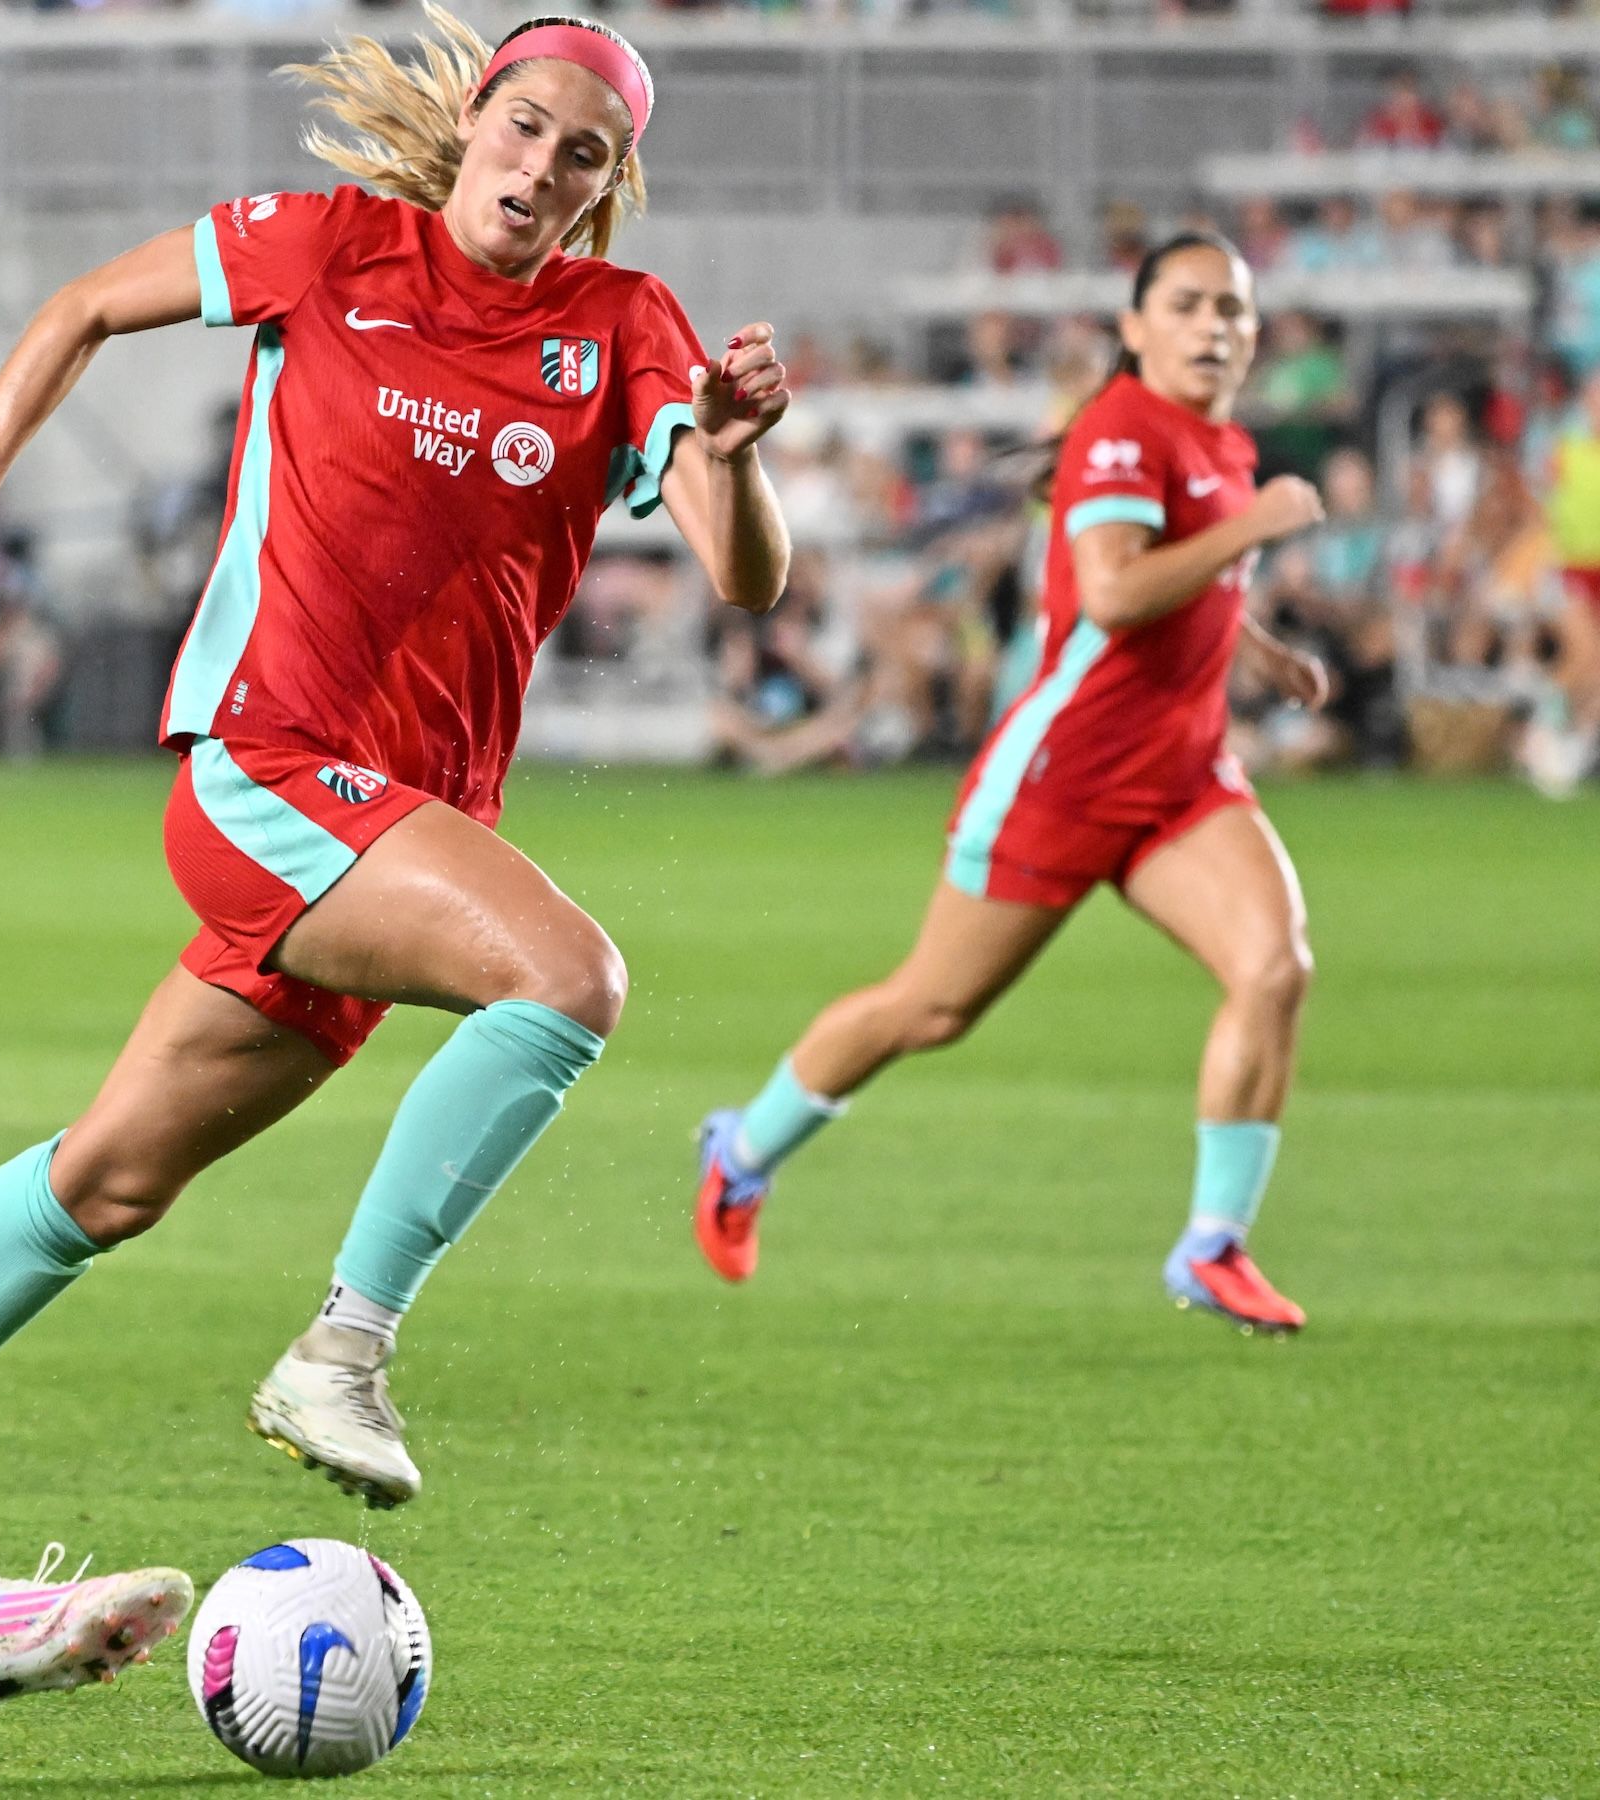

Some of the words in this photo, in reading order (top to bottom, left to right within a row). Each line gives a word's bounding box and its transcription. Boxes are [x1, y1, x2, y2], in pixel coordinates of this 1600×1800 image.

[563, 344, 578, 391] KC
[377, 386, 481, 439] United
[413, 428, 475, 477] Way
